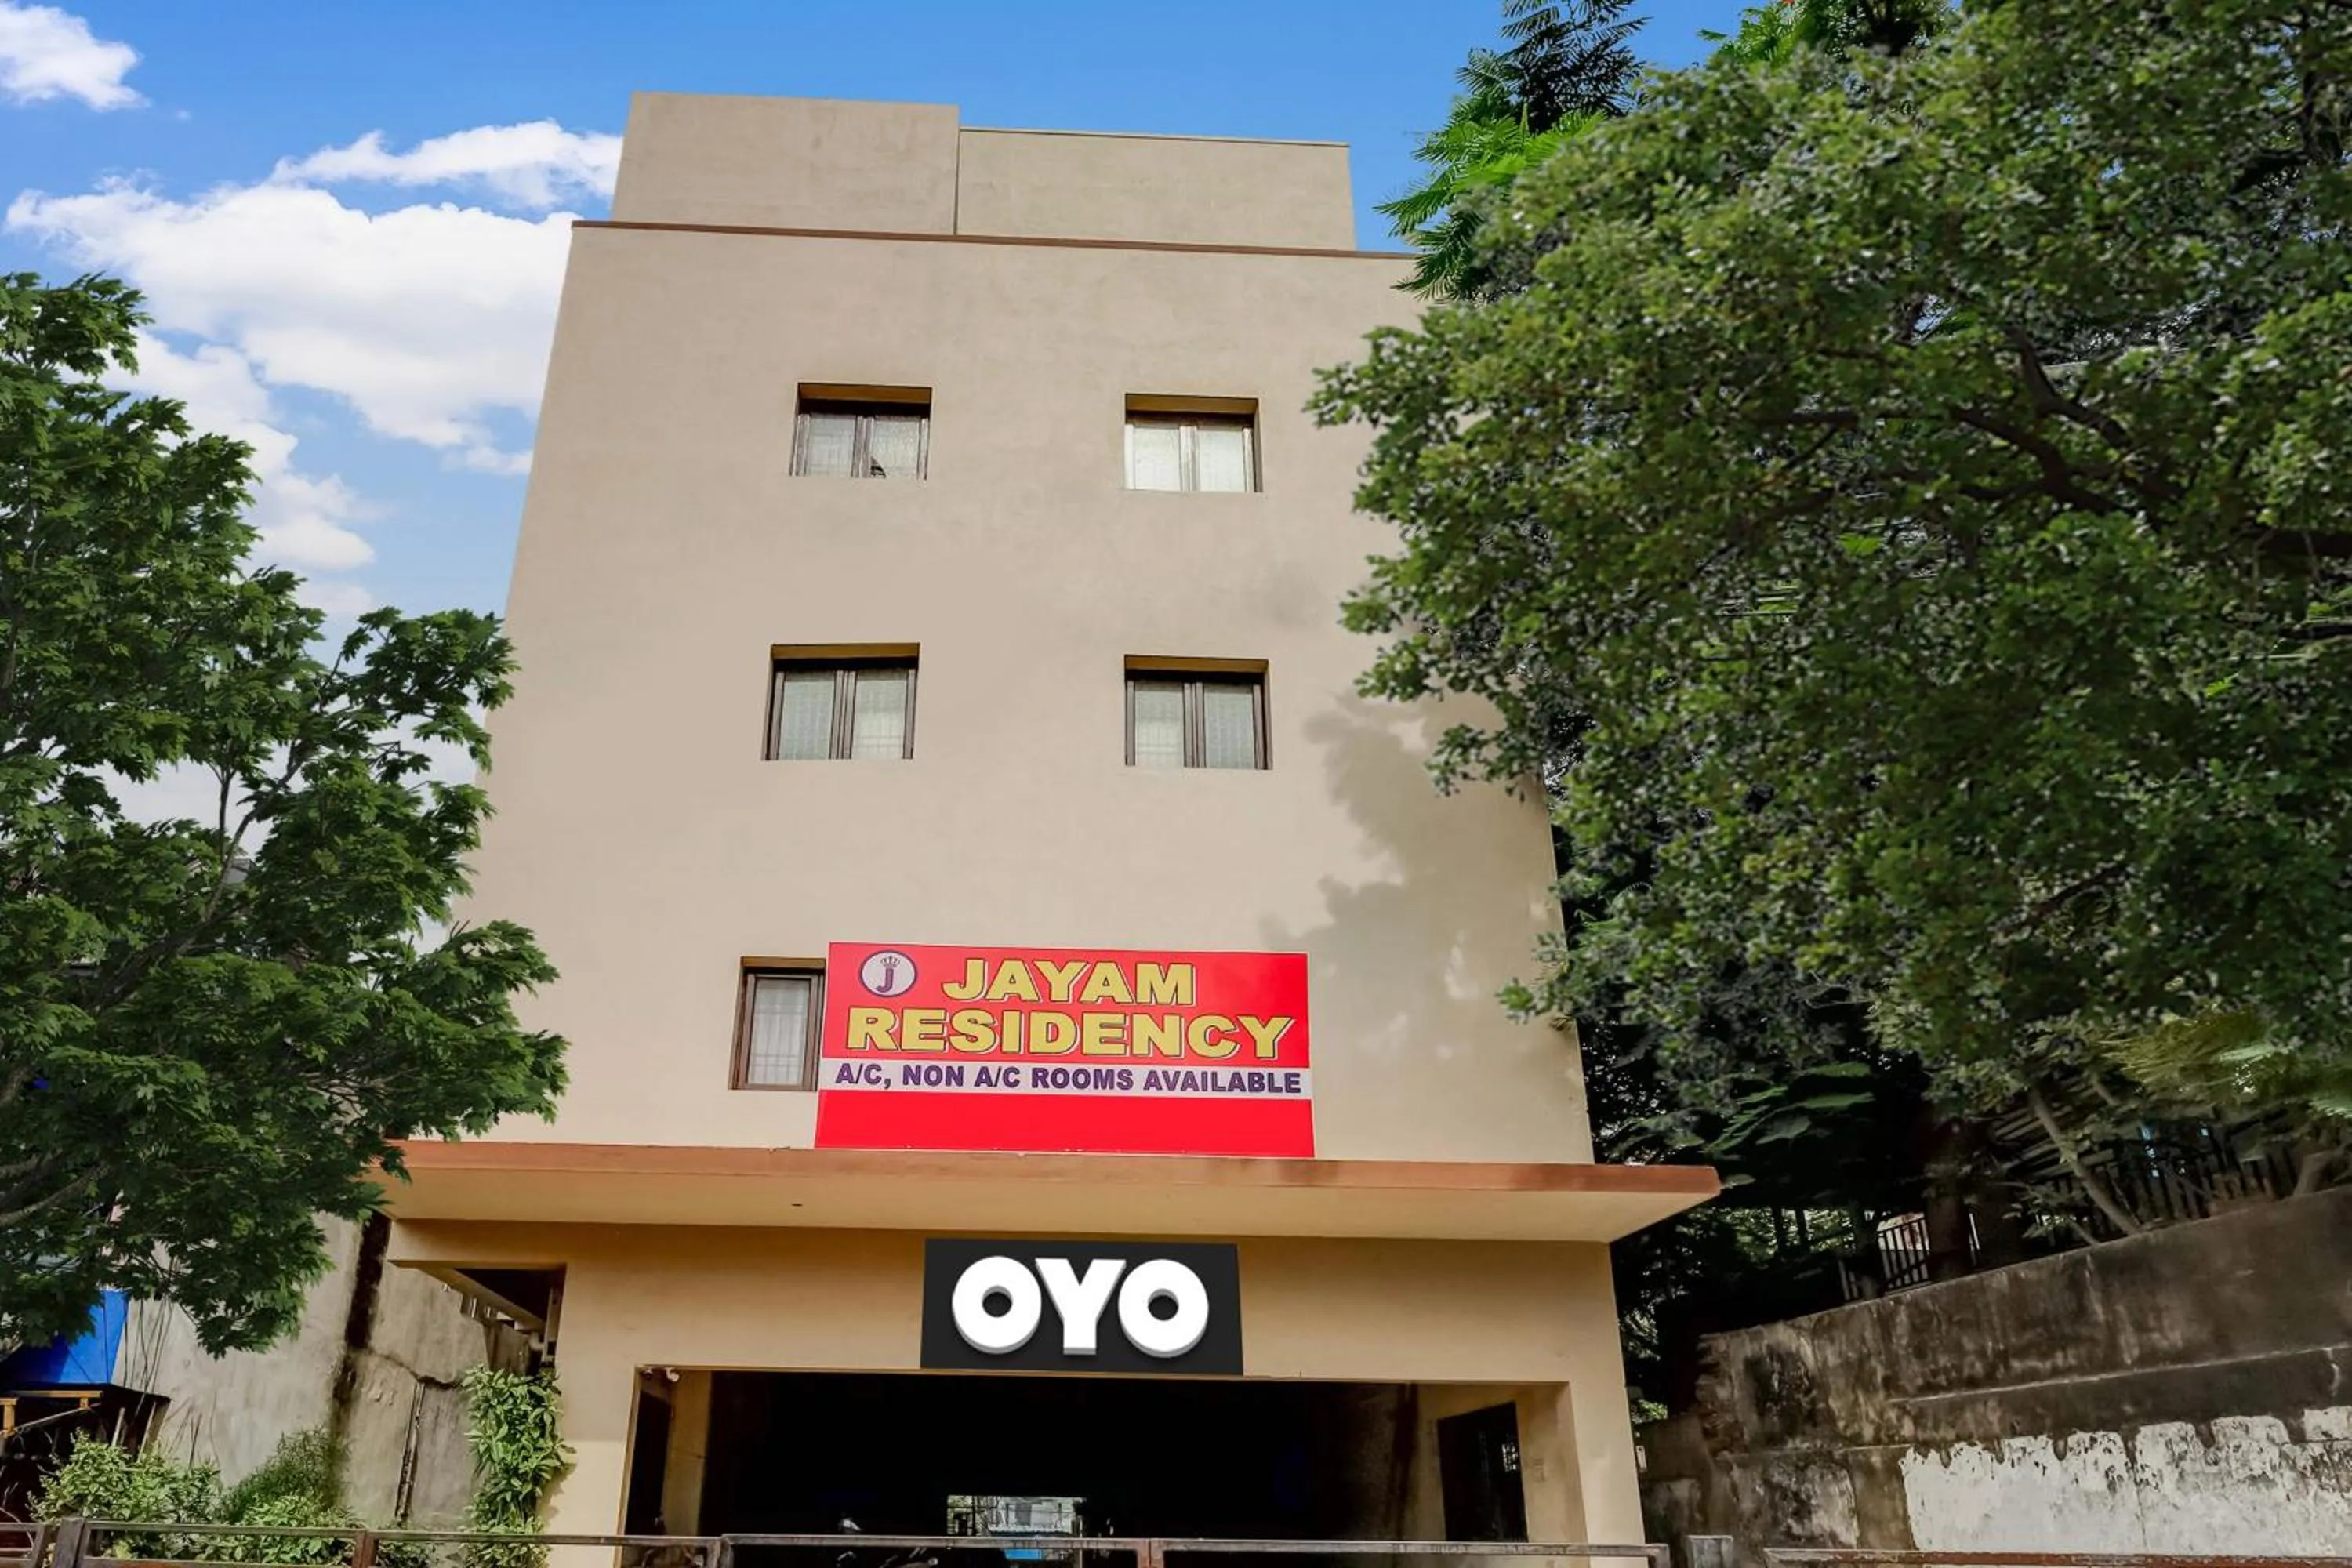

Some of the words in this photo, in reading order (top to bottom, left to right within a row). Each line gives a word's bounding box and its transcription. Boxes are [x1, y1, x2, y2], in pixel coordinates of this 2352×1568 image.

[876, 967, 895, 993] J
[941, 958, 1196, 1006] JAYAM
[846, 1006, 1295, 1058] RESIDENCY
[835, 1063, 891, 1090] A/C,
[902, 1064, 965, 1087] NON
[974, 1065, 1021, 1089] A/C
[1031, 1067, 1134, 1091] ROOMS
[1143, 1069, 1301, 1094] AVAILABLE
[952, 1256, 1209, 1359] OYO
